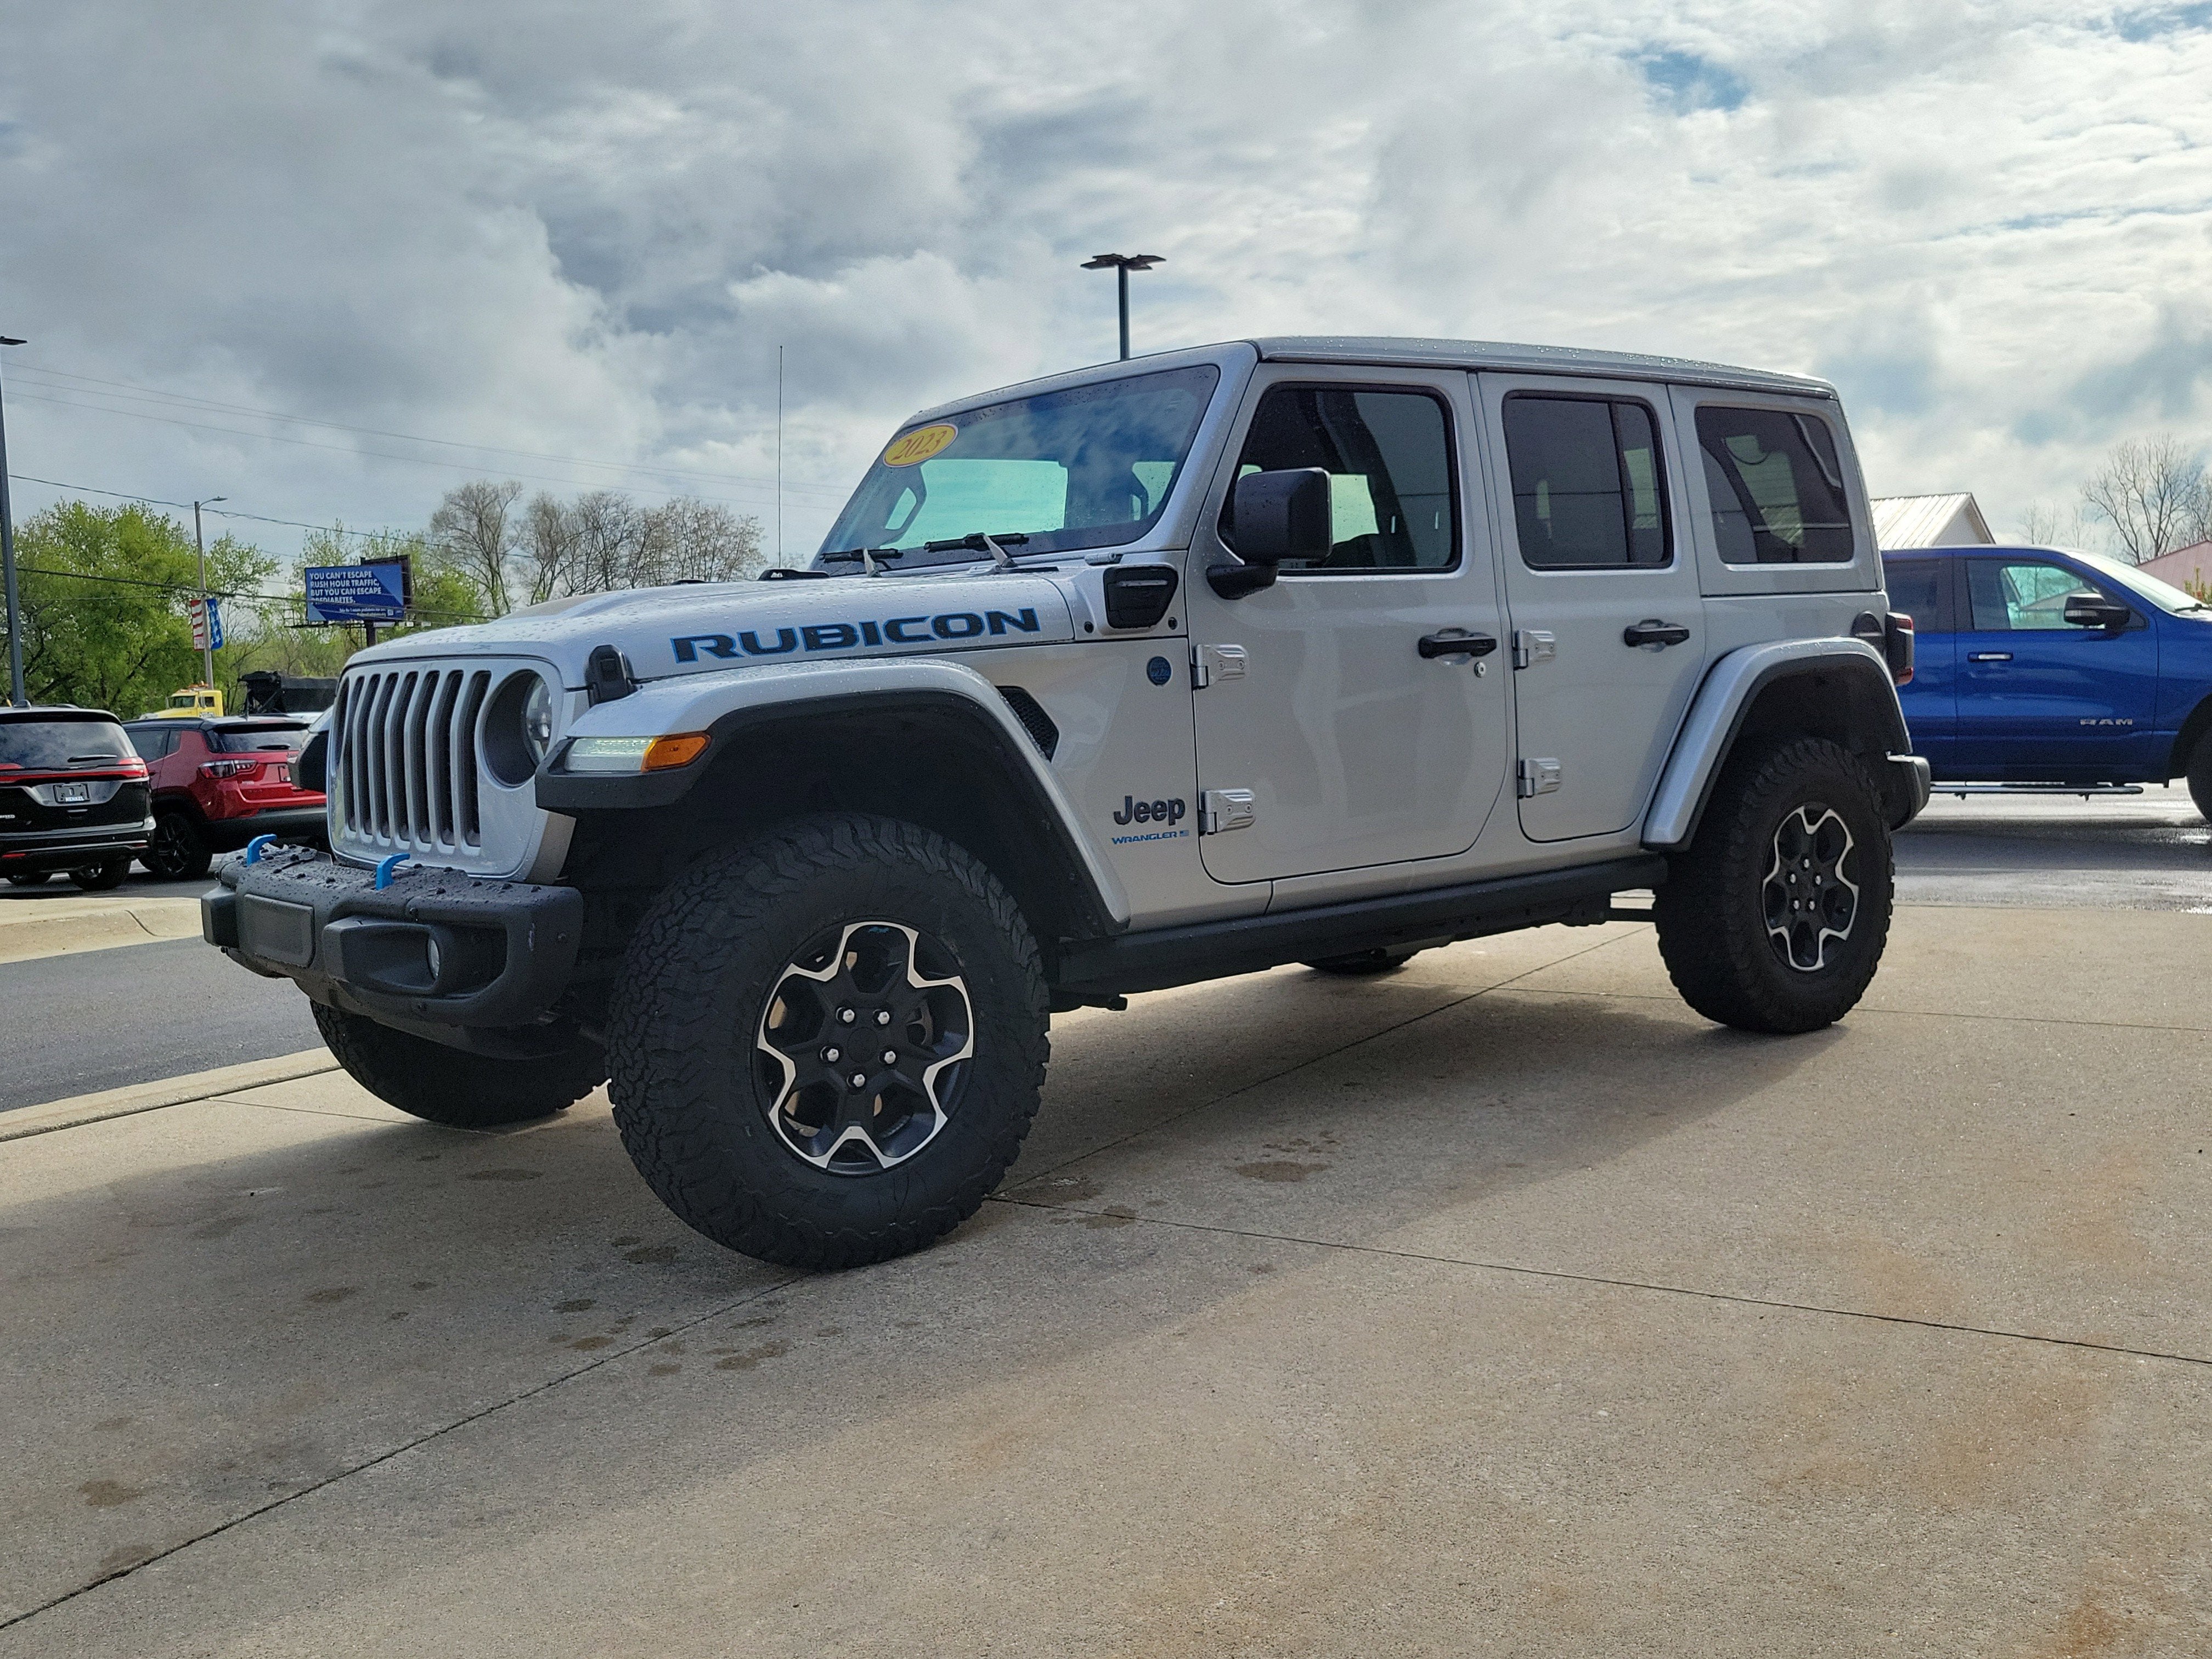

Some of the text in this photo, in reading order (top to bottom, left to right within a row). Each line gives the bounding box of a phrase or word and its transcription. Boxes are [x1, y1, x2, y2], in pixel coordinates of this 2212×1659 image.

[891, 430, 947, 461] 2023
[670, 607, 1041, 663] RUBICON
[1114, 795, 1186, 826] Jeep
[1111, 831, 1177, 844] WRANGLER
